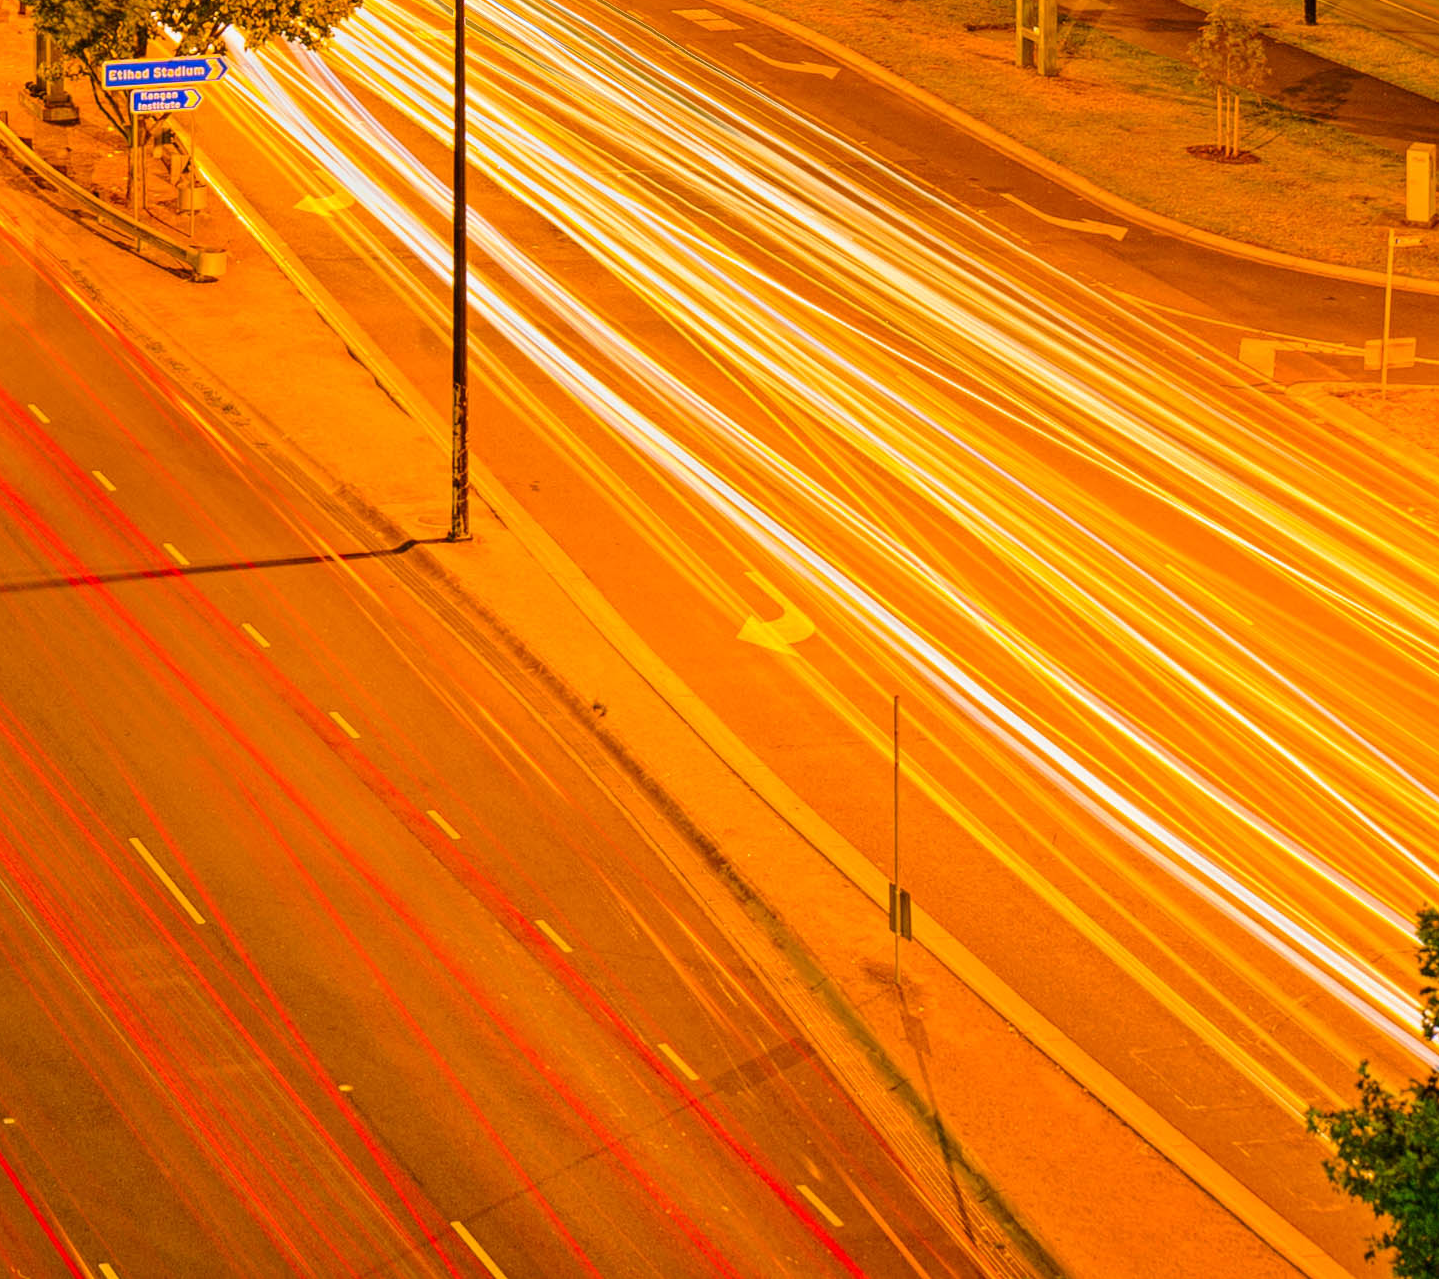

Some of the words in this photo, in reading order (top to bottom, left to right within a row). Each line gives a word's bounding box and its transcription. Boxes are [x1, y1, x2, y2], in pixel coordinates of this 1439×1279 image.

[108, 68, 150, 81] Etihad
[153, 65, 205, 79] Stadium
[140, 91, 178, 101] Kangan
[137, 100, 181, 110] Institute
